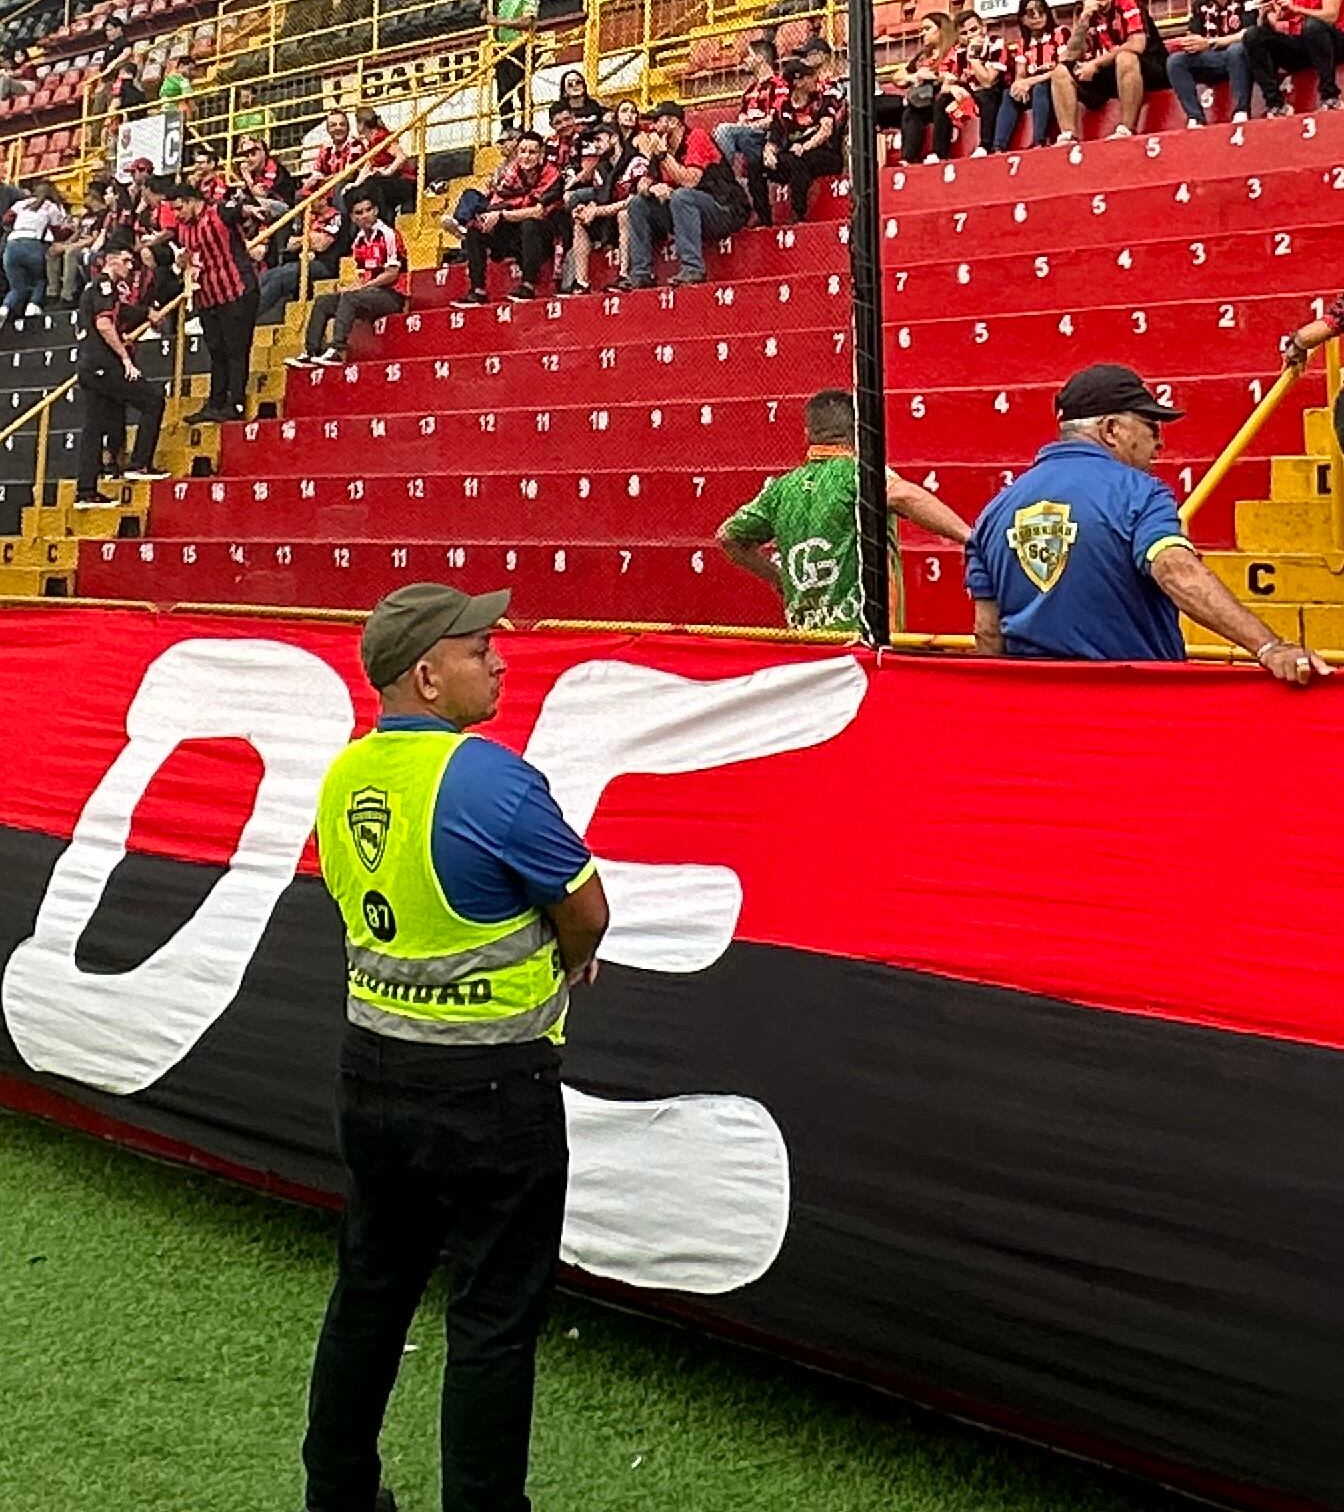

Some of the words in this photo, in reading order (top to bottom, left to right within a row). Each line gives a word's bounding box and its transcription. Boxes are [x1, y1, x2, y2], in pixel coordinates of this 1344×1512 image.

[165, 129, 180, 166] C
[893, 172, 906, 190] 9
[943, 164, 956, 183] 8
[1007, 156, 1021, 176] 7
[1069, 144, 1083, 164] 6
[1146, 136, 1162, 158] 5
[1230, 126, 1244, 146] 4
[1302, 117, 1317, 138] 3
[884, 218, 898, 238] 8
[953, 212, 968, 233] 7
[1014, 202, 1028, 223] 6
[1092, 194, 1106, 214] 5
[1174, 182, 1191, 203] 4
[1247, 178, 1262, 200] 3
[658, 287, 674, 309] 11
[895, 271, 908, 292] 7
[957, 263, 970, 284] 6
[1034, 256, 1050, 278] 5
[1117, 248, 1133, 269] 4
[1189, 242, 1206, 265] 3
[1274, 232, 1292, 256] 2
[898, 327, 911, 348] 6
[974, 322, 989, 344] 5
[1058, 314, 1074, 336] 4
[1131, 310, 1148, 334] 3
[1218, 304, 1236, 328] 2
[1310, 297, 1324, 320] 1
[536, 412, 550, 432] 11
[766, 400, 778, 422] 7
[910, 394, 926, 418] 5
[994, 391, 1010, 414] 4
[1156, 384, 1174, 408] 2
[1248, 379, 1262, 404] 1
[922, 470, 940, 493] 4
[1178, 466, 1192, 493] 1
[391, 548, 407, 568] 11
[619, 550, 632, 574] 7
[691, 550, 704, 574] 6
[926, 556, 941, 582] 3
[1248, 562, 1275, 595] C
